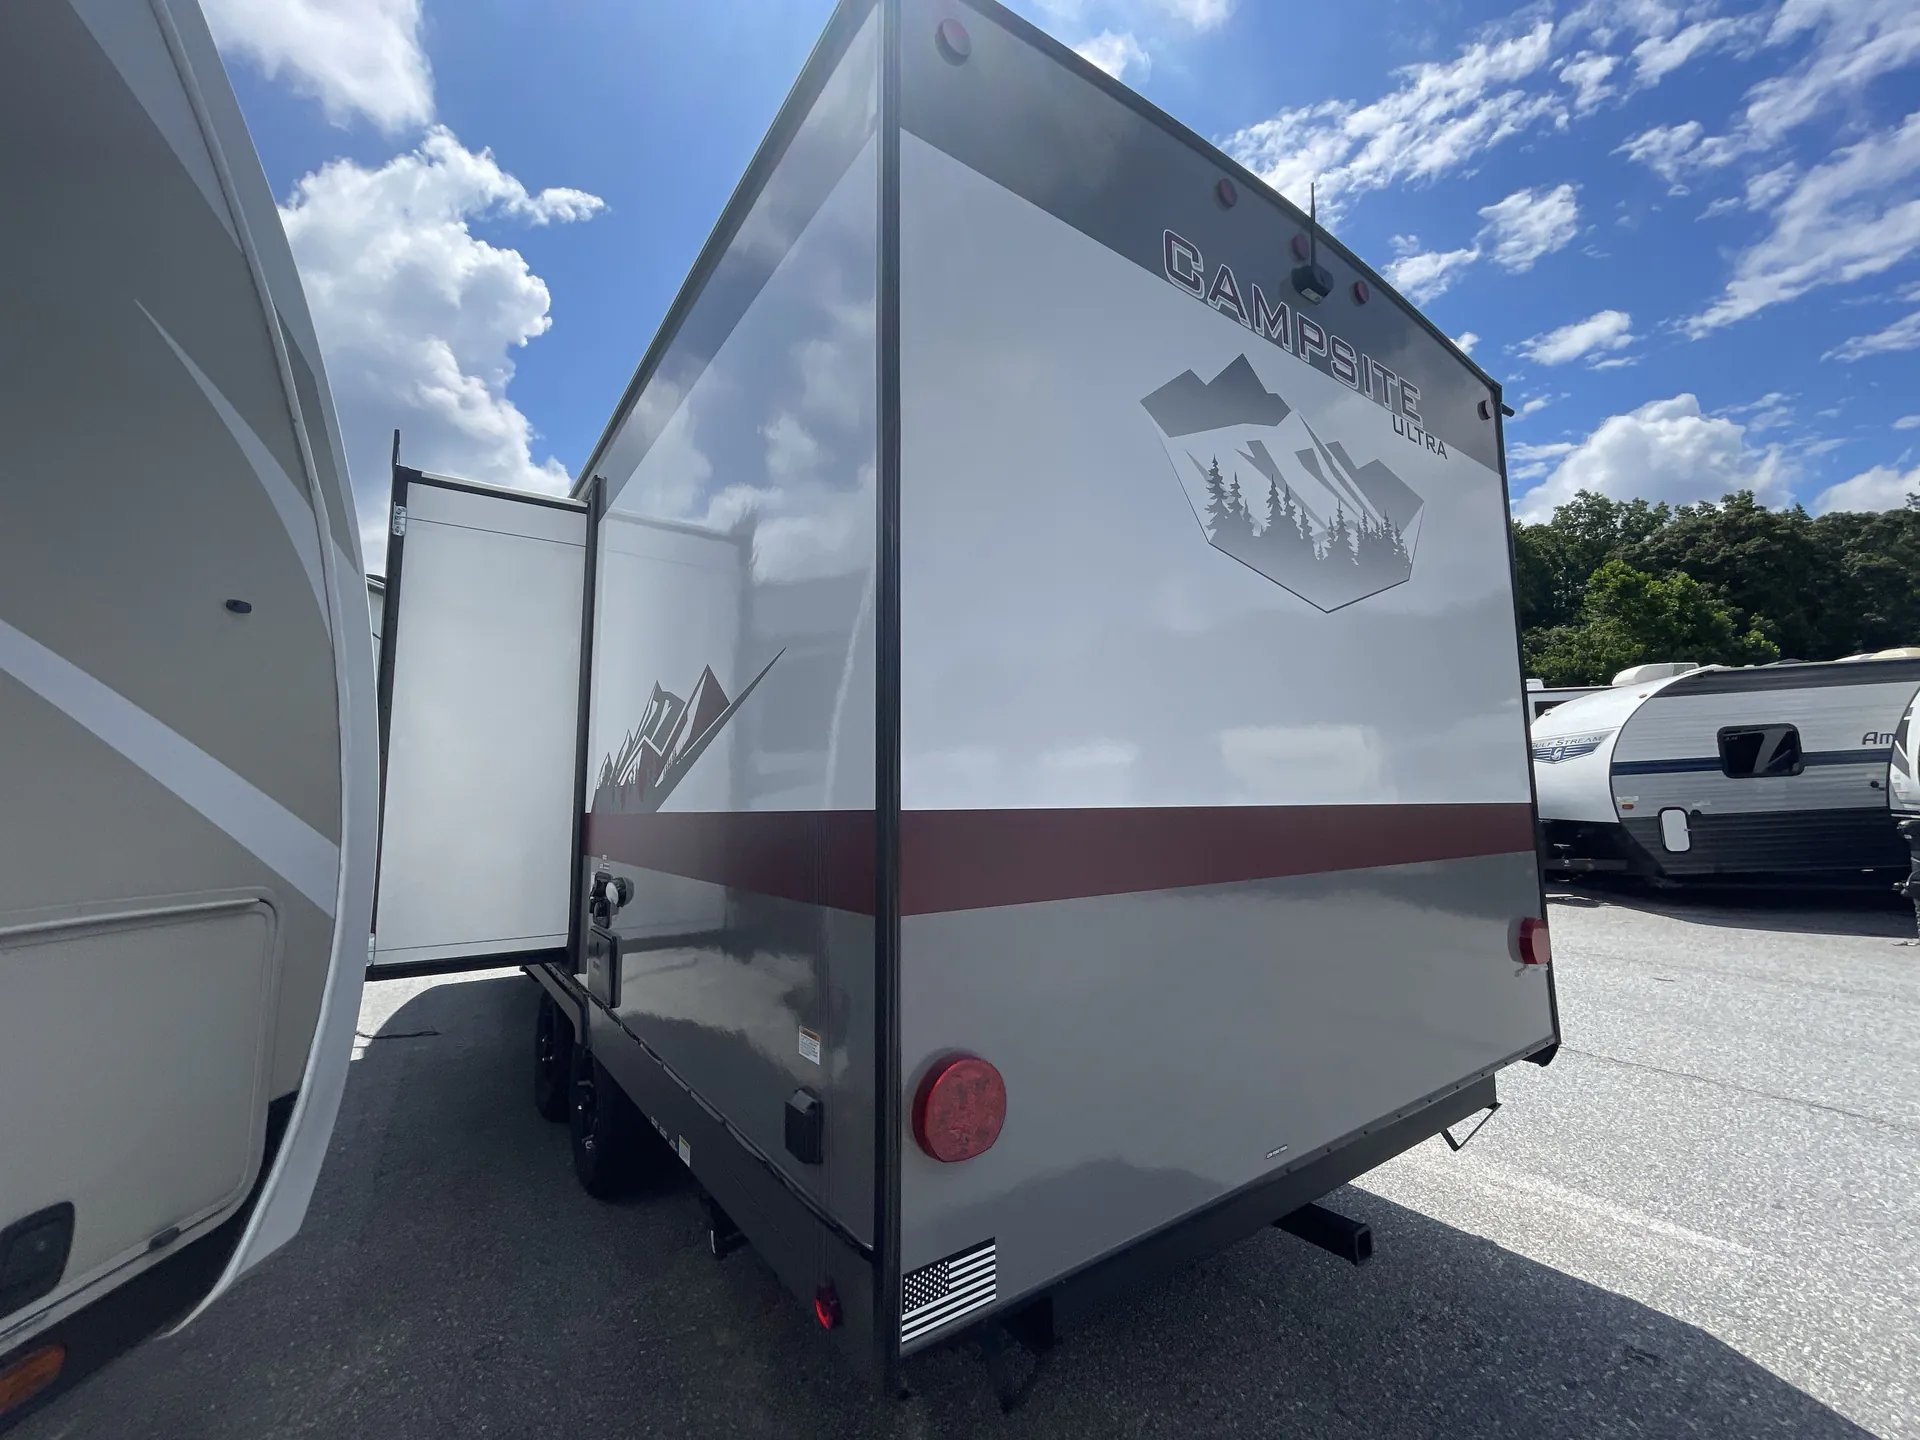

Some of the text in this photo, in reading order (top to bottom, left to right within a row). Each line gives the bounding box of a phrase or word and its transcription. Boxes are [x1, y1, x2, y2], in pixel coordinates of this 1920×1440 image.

[1163, 229, 1423, 428] CAMPSITE
[1392, 414, 1448, 460] ULTRA
[1555, 736, 1603, 746] STREAM
